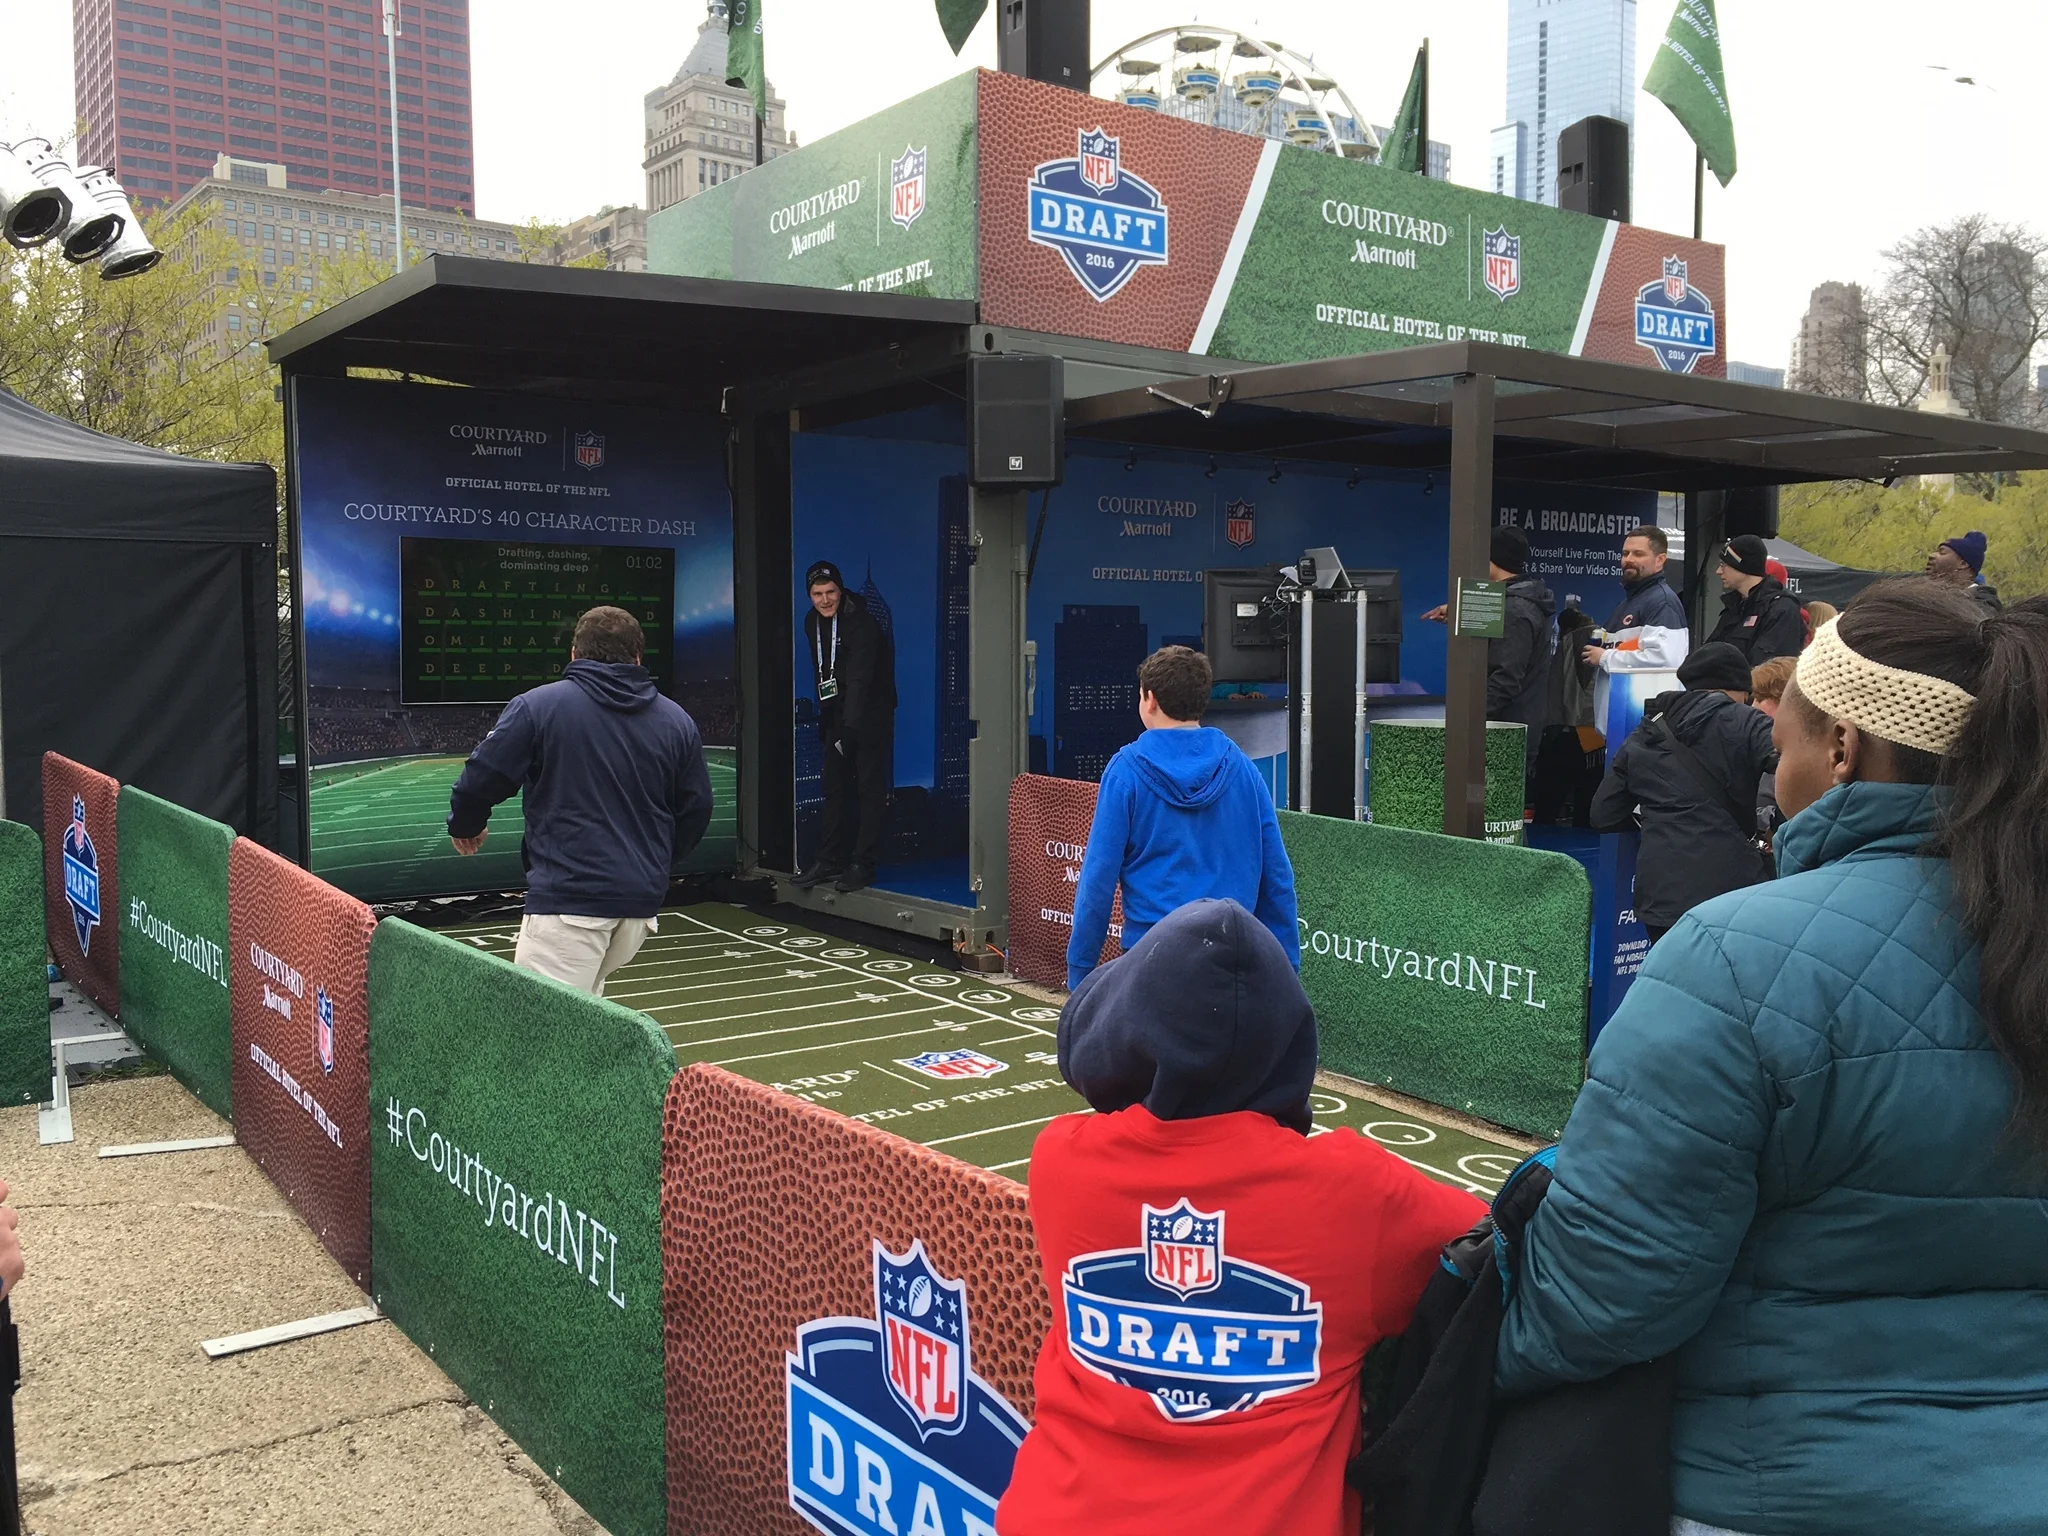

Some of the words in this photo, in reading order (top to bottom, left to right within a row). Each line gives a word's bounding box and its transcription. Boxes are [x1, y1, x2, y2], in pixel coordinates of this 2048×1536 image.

[1669, 41, 1695, 65] HOTEL
[1692, 64, 1706, 76] OF
[1703, 75, 1719, 96] THE
[1083, 154, 1114, 186] NFL
[894, 178, 922, 218] NFL
[1040, 198, 1157, 246] DRAFT
[787, 219, 836, 260] Marriott
[1350, 238, 1417, 270] Marriott
[877, 267, 904, 292] THE
[906, 259, 933, 284] NFL
[1085, 252, 1115, 269] 2016
[1487, 255, 1516, 290] NFL
[1666, 276, 1686, 298] NFL
[1315, 303, 1390, 332] OFFICIAL
[1393, 315, 1443, 340] HOTEL
[1447, 324, 1466, 341] OF
[1469, 327, 1499, 344] THE
[1642, 311, 1709, 342] DRAFT
[1668, 349, 1686, 361] 2016
[450, 424, 547, 445] COURTYARD
[471, 443, 522, 457] Marriott
[577, 447, 601, 465] NFL
[446, 477, 501, 490] OFFICIAL
[504, 480, 543, 493] HOTEL
[546, 483, 560, 493] OF
[563, 484, 586, 496] THE
[588, 486, 611, 497] NFL
[344, 503, 492, 525] COURTYARD'S
[497, 510, 520, 526] 40
[525, 511, 642, 533] CHARACTER
[647, 519, 696, 536] DASH
[1097, 496, 1197, 519] COURTYARD
[1500, 507, 1519, 527] BE
[1523, 509, 1535, 530] A
[1119, 519, 1172, 537] Marriott
[1228, 520, 1252, 542] NFL
[498, 548, 544, 560] Drafting,
[548, 549, 591, 561] dashing,
[500, 560, 560, 573] dominating
[563, 562, 589, 573] deep
[626, 555, 662, 569] 01:02
[1529, 546, 1563, 559] Yourself
[1565, 547, 1582, 560] Live
[1584, 549, 1606, 561] From
[1607, 550, 1621, 561] The
[1531, 563, 1537, 573] &
[1539, 562, 1563, 574] Share
[1565, 563, 1584, 575] Your
[1586, 564, 1609, 576] Video
[1092, 567, 1150, 581] OFFICIAL
[1152, 569, 1193, 582] HOTEL
[66, 861, 96, 907] DRAFT
[130, 895, 228, 989] #CourtyardNFL
[251, 941, 304, 999] COURTYARD
[263, 983, 292, 1022] Marriott
[924, 1057, 999, 1078] NFL
[250, 1042, 282, 1084] OFFICIAL
[282, 1068, 303, 1106] HOTEL
[303, 1090, 313, 1115] OF
[313, 1099, 327, 1132] THE
[326, 1117, 343, 1149] NFL
[912, 1099, 949, 1113] OF
[951, 1087, 1014, 1105] THE
[386, 1095, 626, 1310] #CourtyardNFL
[1153, 1242, 1213, 1287] NFL
[1077, 1304, 1300, 1367] DRAFT
[887, 1316, 957, 1417] NFL
